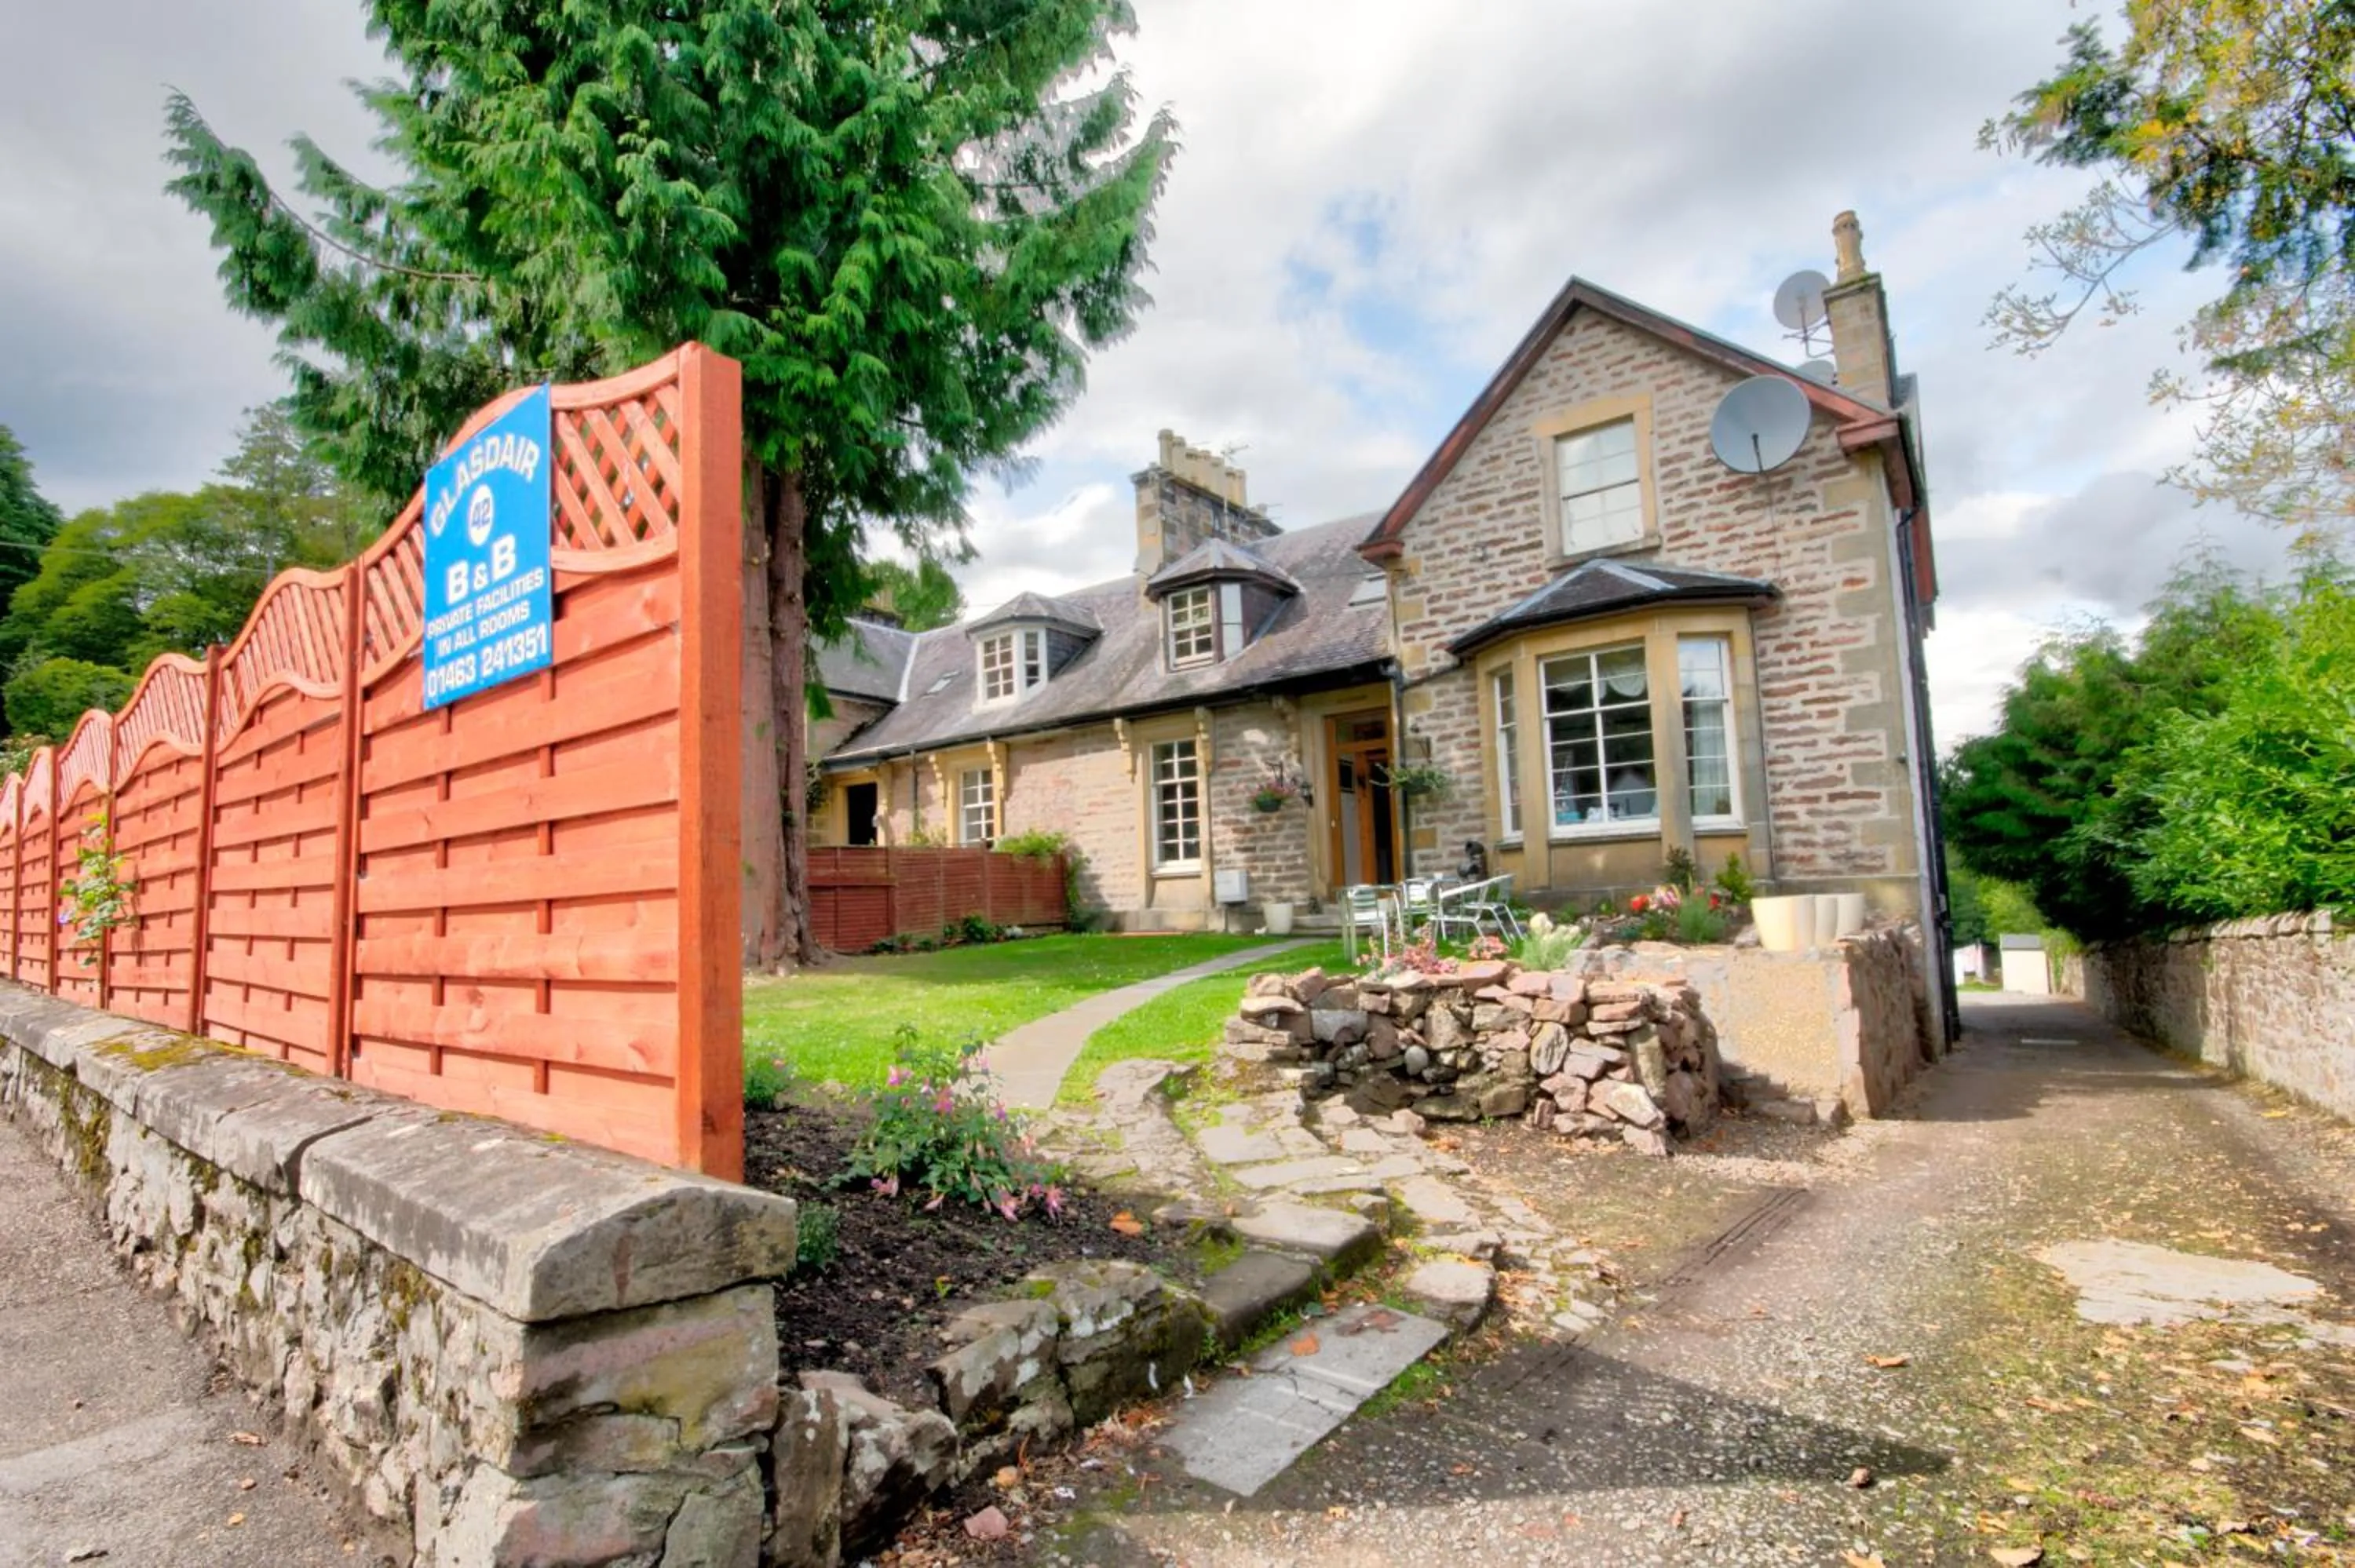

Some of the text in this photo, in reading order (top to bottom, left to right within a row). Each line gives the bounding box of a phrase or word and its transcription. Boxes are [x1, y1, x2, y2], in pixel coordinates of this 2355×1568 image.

[430, 433, 540, 538] GLASDAIR
[471, 497, 491, 530] 42
[426, 567, 544, 640] PRIVATE FACILITIES
[438, 599, 531, 658] IN ALL ROOMS
[426, 622, 547, 698] 01463 241351
